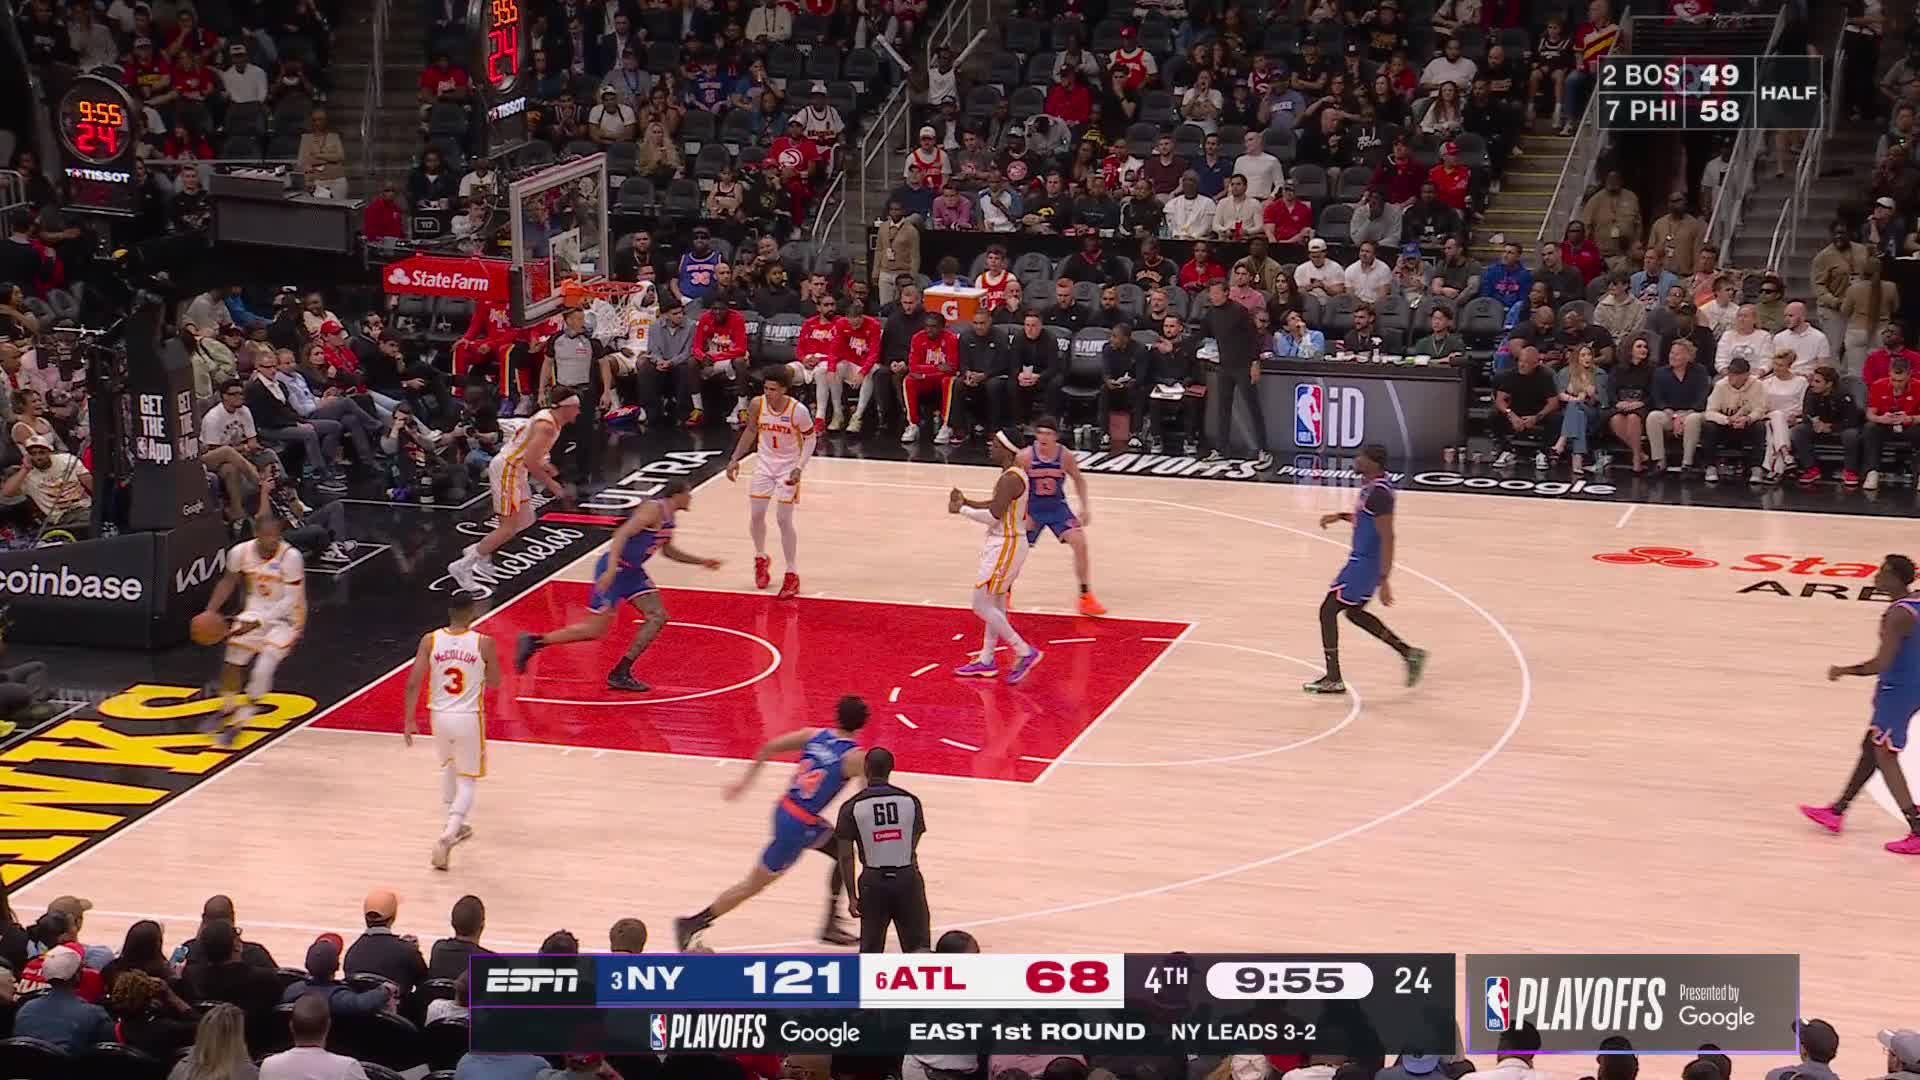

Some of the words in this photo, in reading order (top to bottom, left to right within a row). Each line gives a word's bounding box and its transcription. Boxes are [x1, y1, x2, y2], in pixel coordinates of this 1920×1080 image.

[488, 26, 518, 83] 24
[79, 101, 122, 125] 9:55
[76, 123, 117, 153] 24
[82, 169, 130, 183] TISSOT
[941, 301, 959, 320] G
[140, 394, 163, 416] GET
[141, 416, 166, 437] THE
[148, 438, 172, 464] App
[578, 450, 724, 511] ULTRA
[1414, 472, 1617, 494] Google
[443, 667, 465, 695] 3
[873, 802, 899, 826] 60
